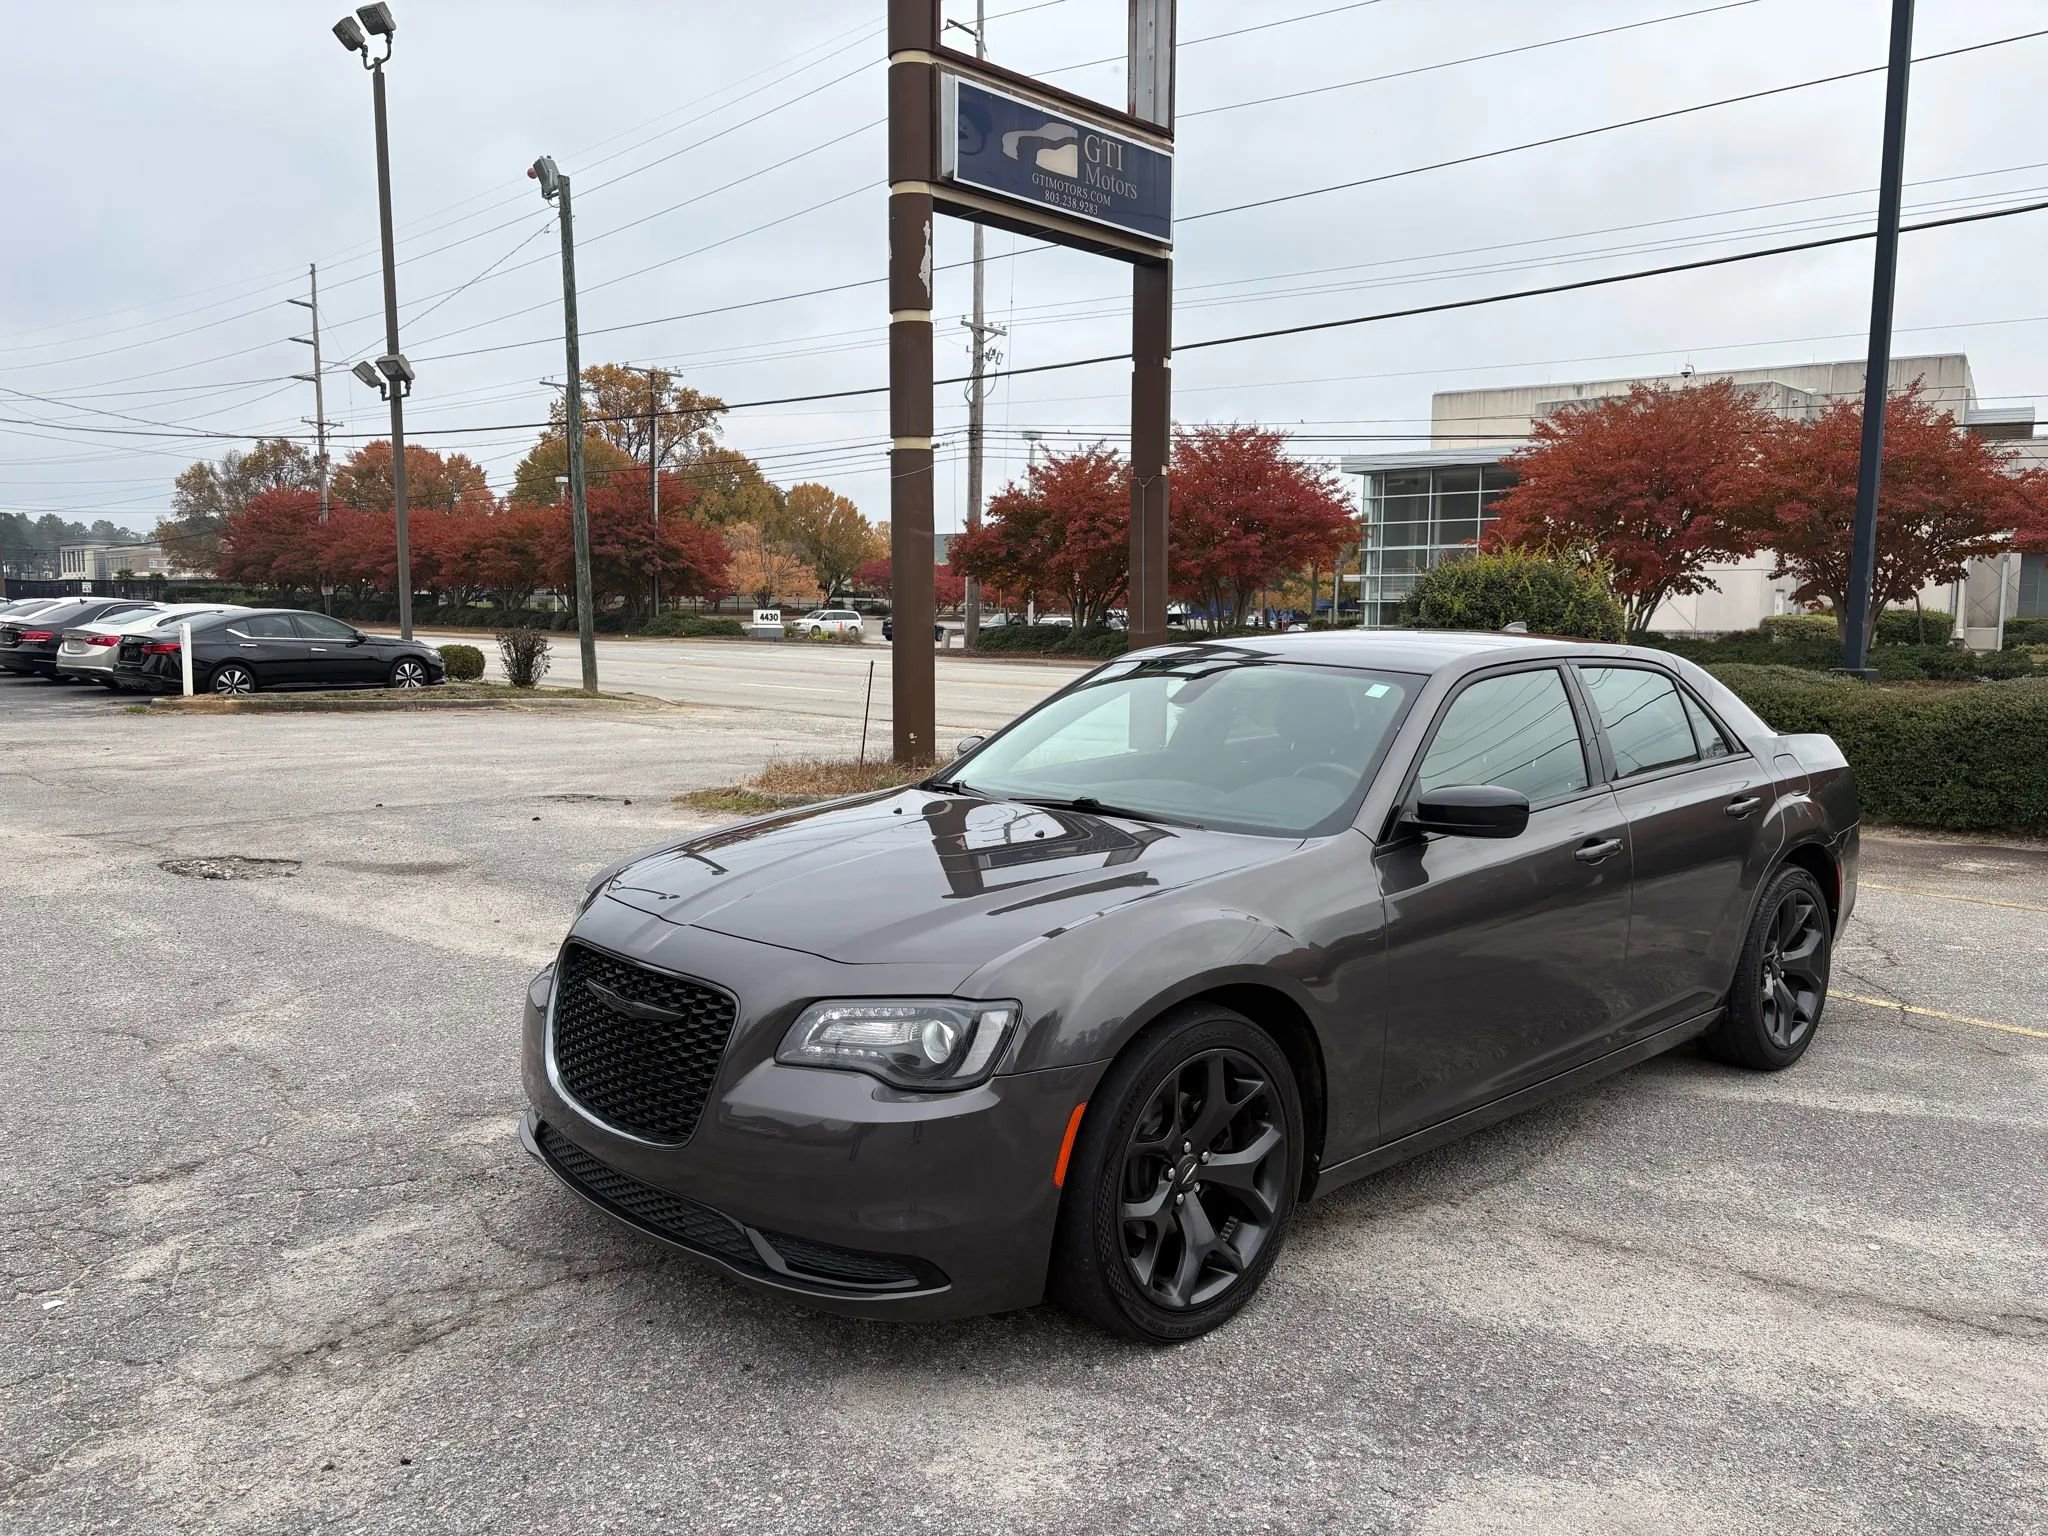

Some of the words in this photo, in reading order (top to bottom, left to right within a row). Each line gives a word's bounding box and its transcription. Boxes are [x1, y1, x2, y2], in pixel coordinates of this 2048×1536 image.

[1084, 134, 1124, 171] GTI
[1032, 173, 1111, 206] GTIMOTORS.COM
[1085, 163, 1137, 199] Motors
[1044, 190, 1098, 215] 803.238.9283
[760, 613, 779, 621] 4430
